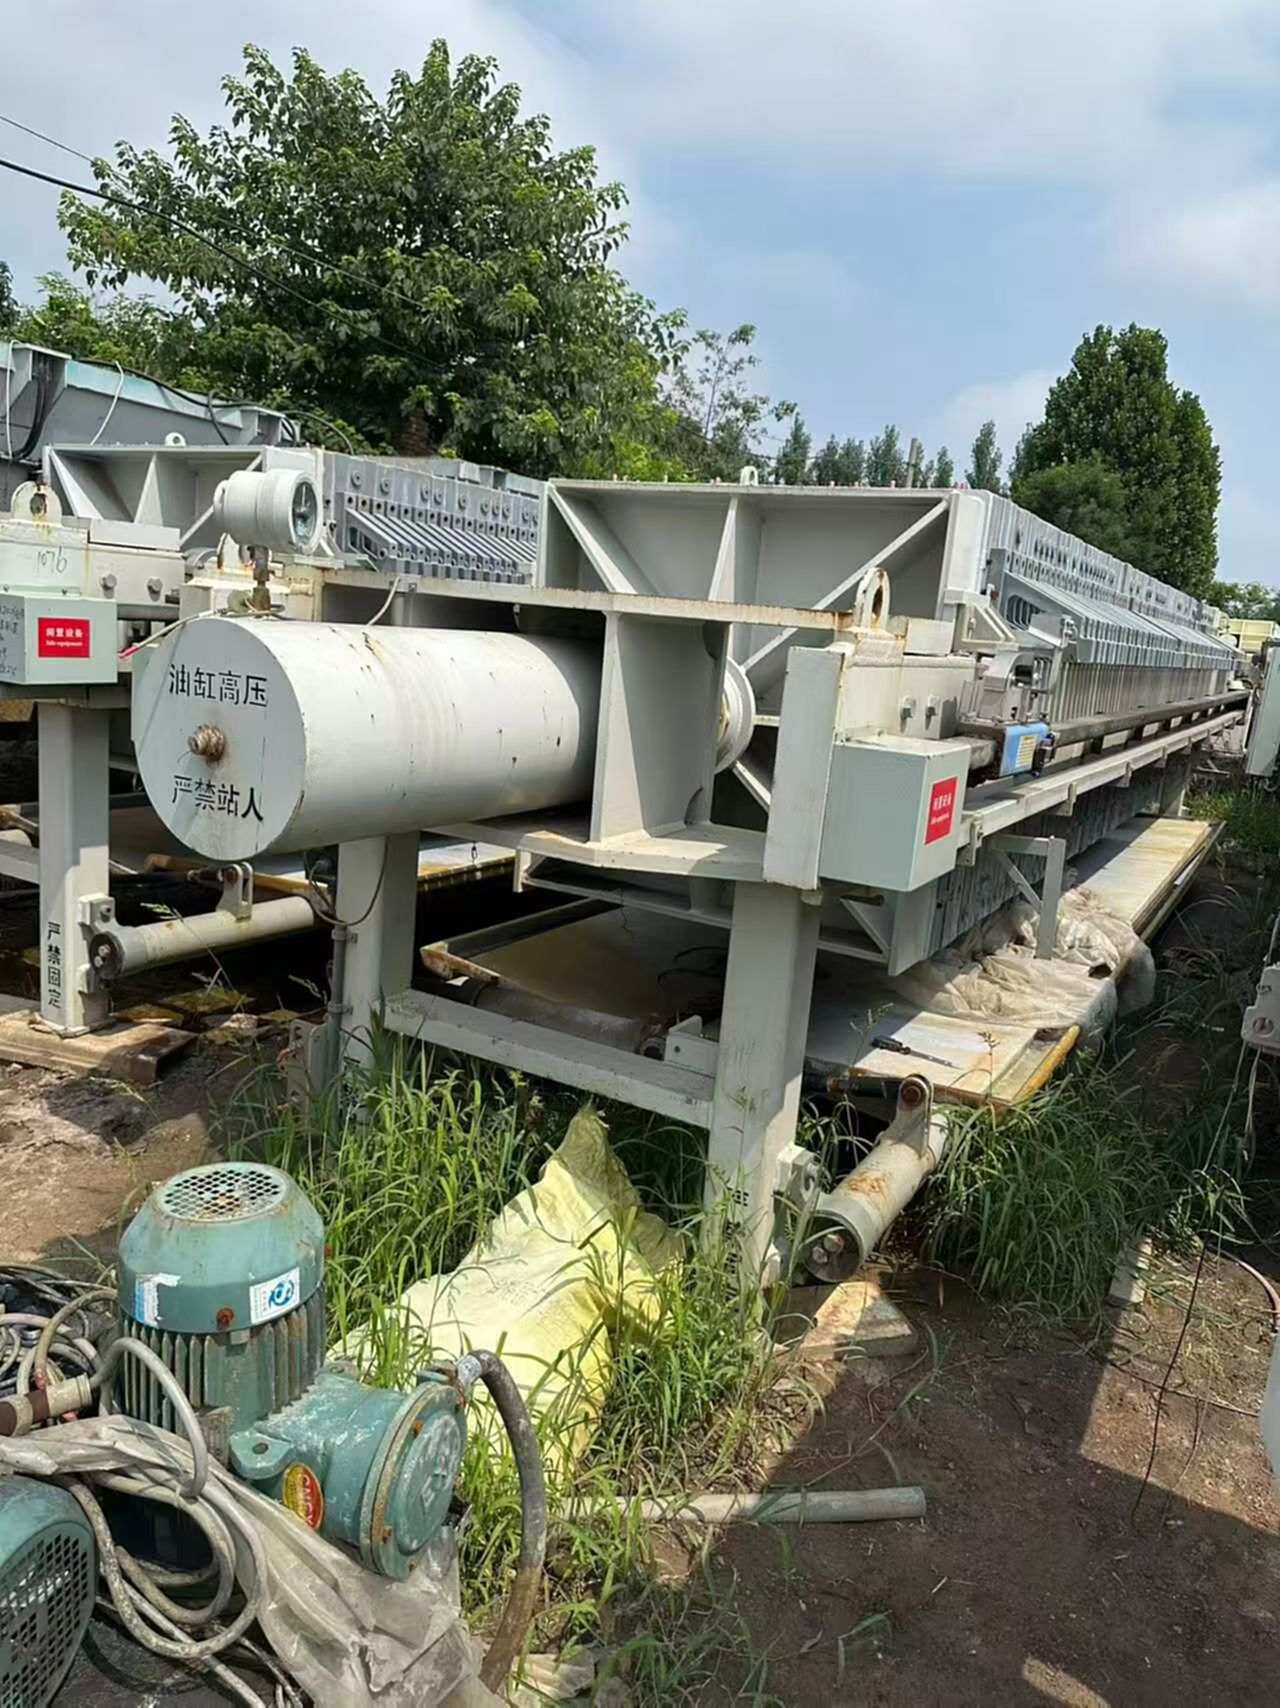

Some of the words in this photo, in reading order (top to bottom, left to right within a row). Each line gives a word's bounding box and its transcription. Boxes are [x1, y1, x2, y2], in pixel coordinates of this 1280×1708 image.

[169, 664, 268, 707] 油缸高压
[172, 775, 264, 822] 严禁站人
[47, 921, 61, 1009] 严禁固定
